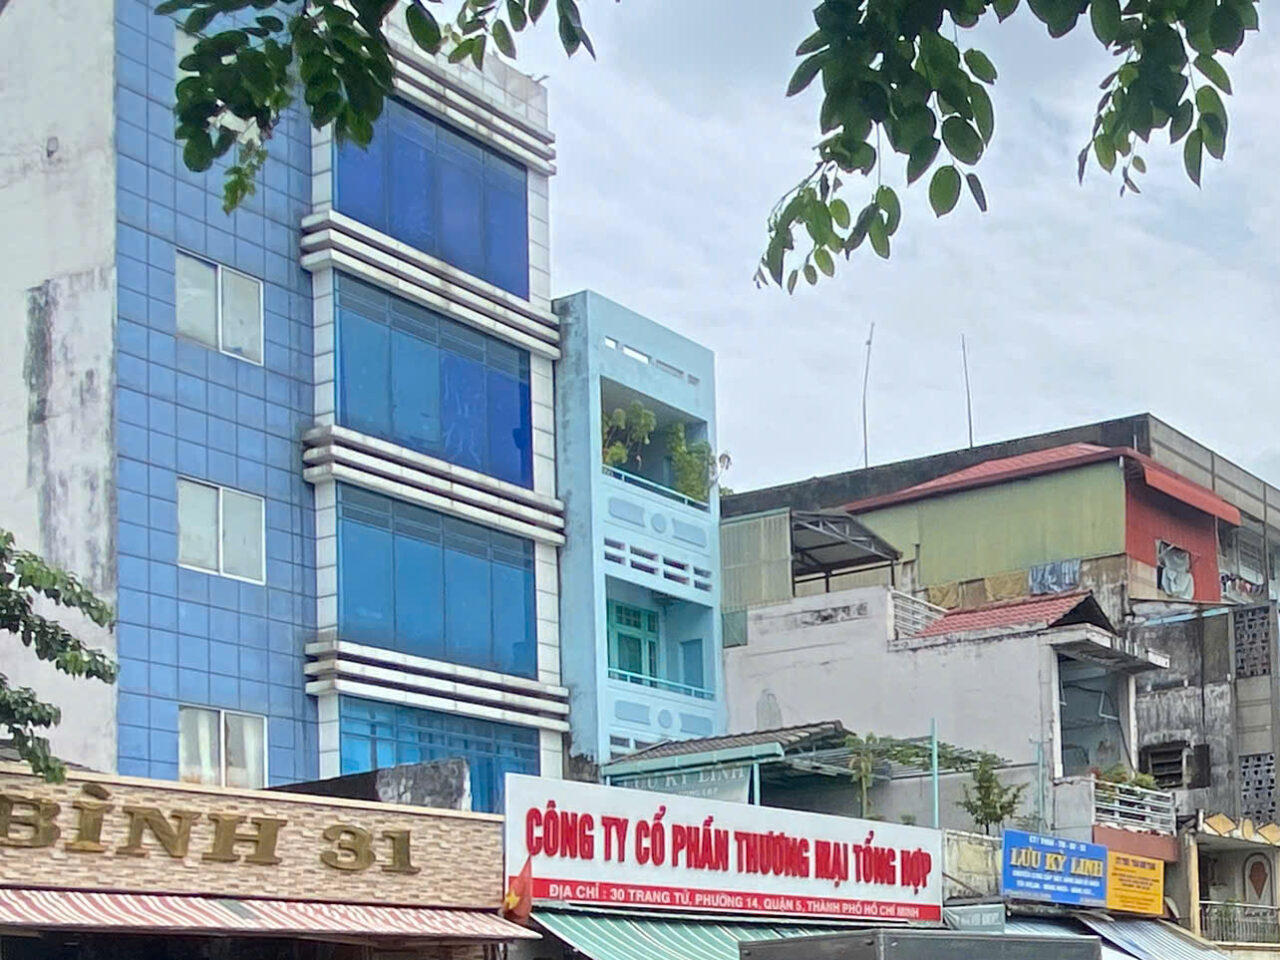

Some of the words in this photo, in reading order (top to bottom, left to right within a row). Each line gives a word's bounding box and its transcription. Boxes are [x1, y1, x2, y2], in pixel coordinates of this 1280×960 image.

[0, 783, 288, 866] BÌNH
[320, 824, 422, 875] 31
[526, 799, 595, 860] CÔNG
[601, 816, 629, 863] TY
[635, 805, 667, 867] CỔ
[734, 830, 810, 879] THƯƠNG
[815, 840, 849, 888] MẠI
[853, 830, 896, 885] TỔNG
[901, 847, 932, 895] HỢP
[549, 883, 573, 899] ĐỊA
[576, 882, 600, 898] CHỈ
[610, 888, 625, 900] 30
[629, 889, 670, 904] TRANG
